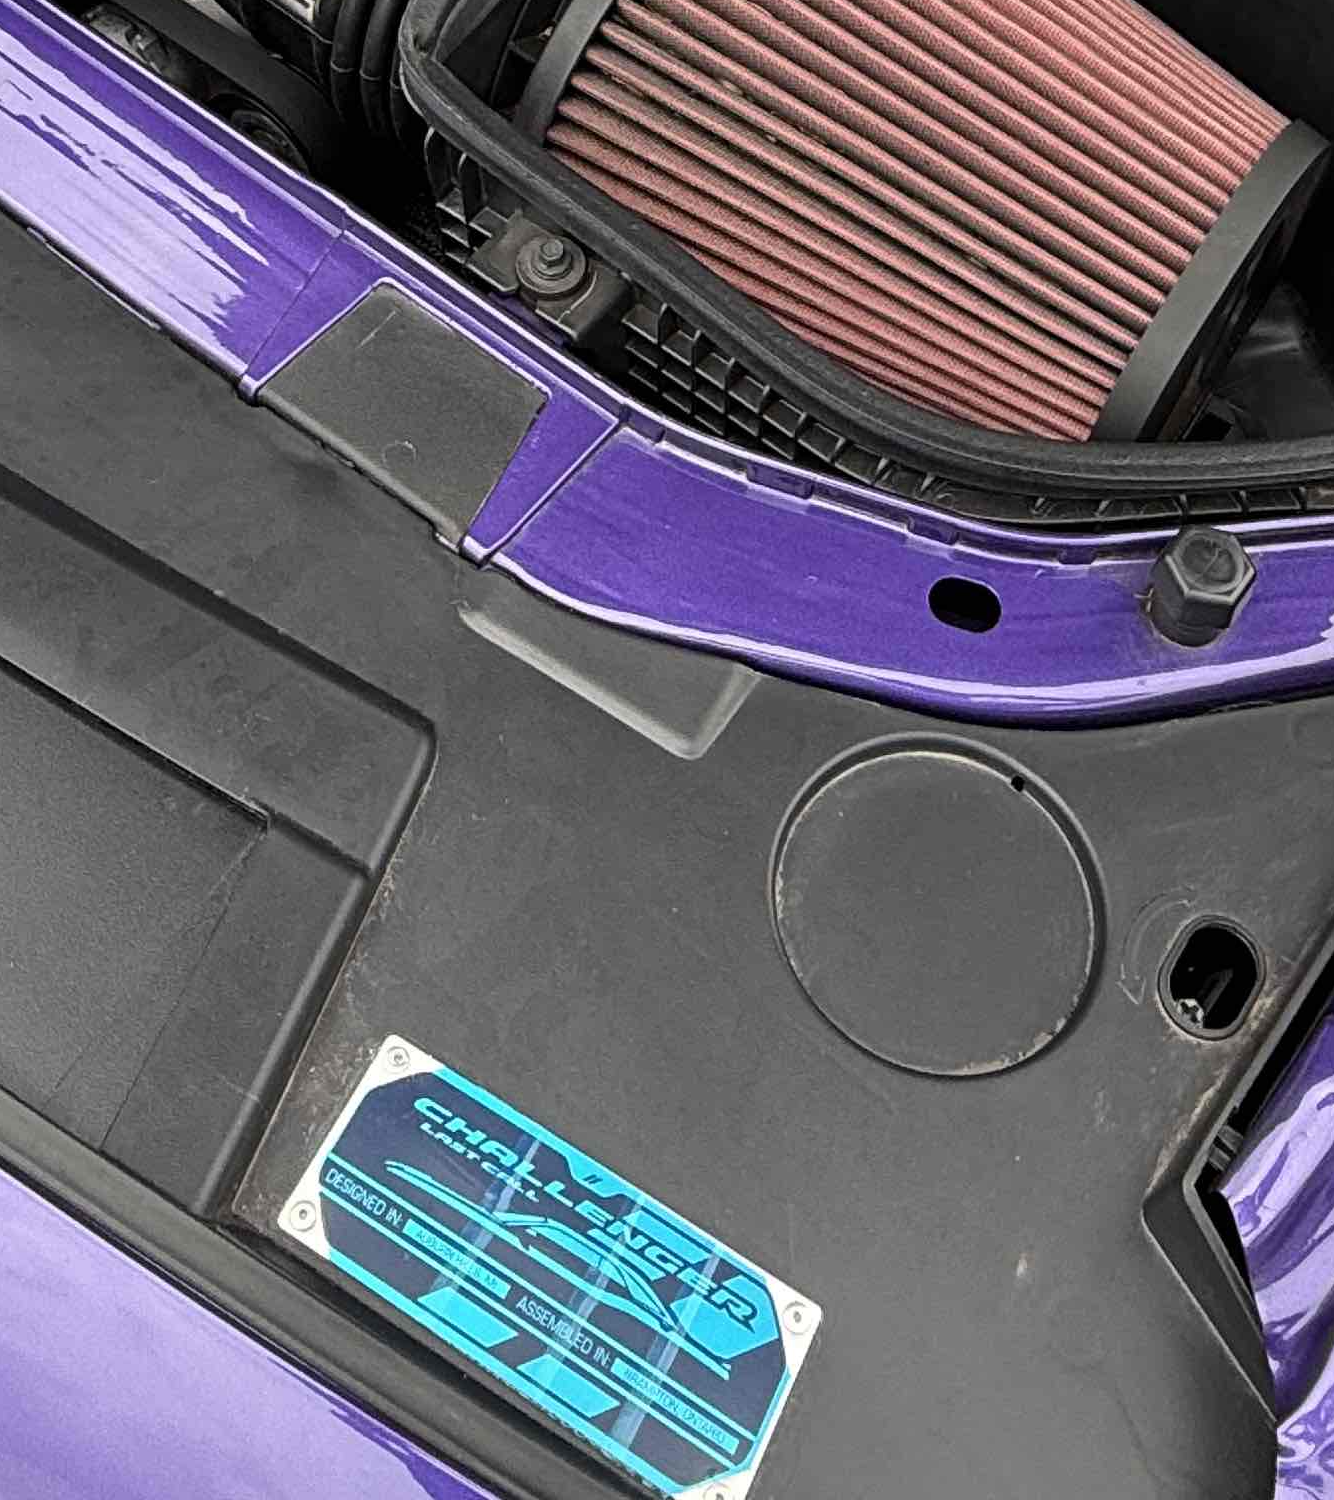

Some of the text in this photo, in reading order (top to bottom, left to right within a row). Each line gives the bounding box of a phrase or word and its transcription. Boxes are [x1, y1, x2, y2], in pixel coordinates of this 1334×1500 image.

[419, 1122, 481, 1161] LAST
[324, 1167, 386, 1216] DESIGNED
[413, 1097, 760, 1334] CHALLENGER
[515, 1295, 594, 1355] ASSEMBLED
